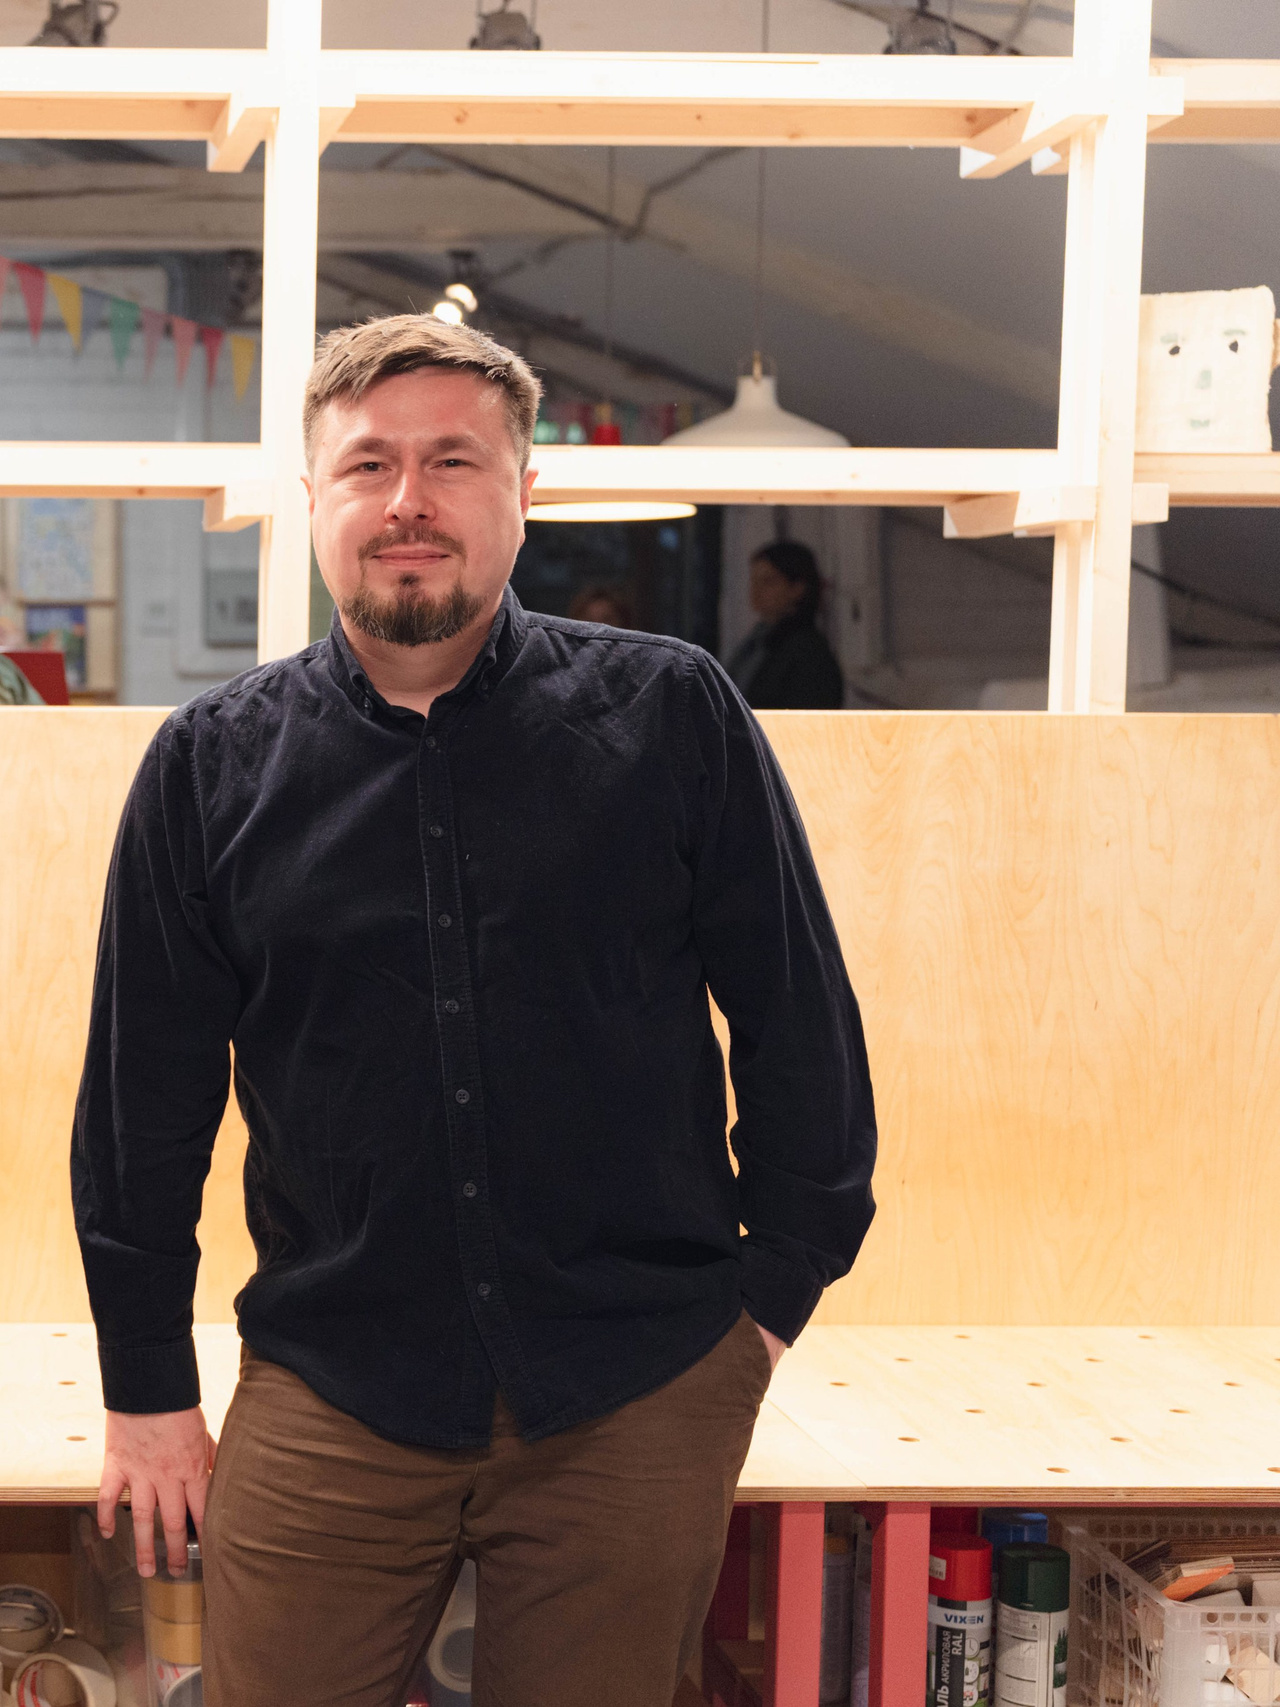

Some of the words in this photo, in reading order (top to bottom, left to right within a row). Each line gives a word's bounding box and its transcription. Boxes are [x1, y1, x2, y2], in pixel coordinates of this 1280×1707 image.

[944, 1613, 985, 1625] VIXEN
[951, 1632, 963, 1655] RAL
[941, 1630, 951, 1684] АКРИЛОВАЯ
